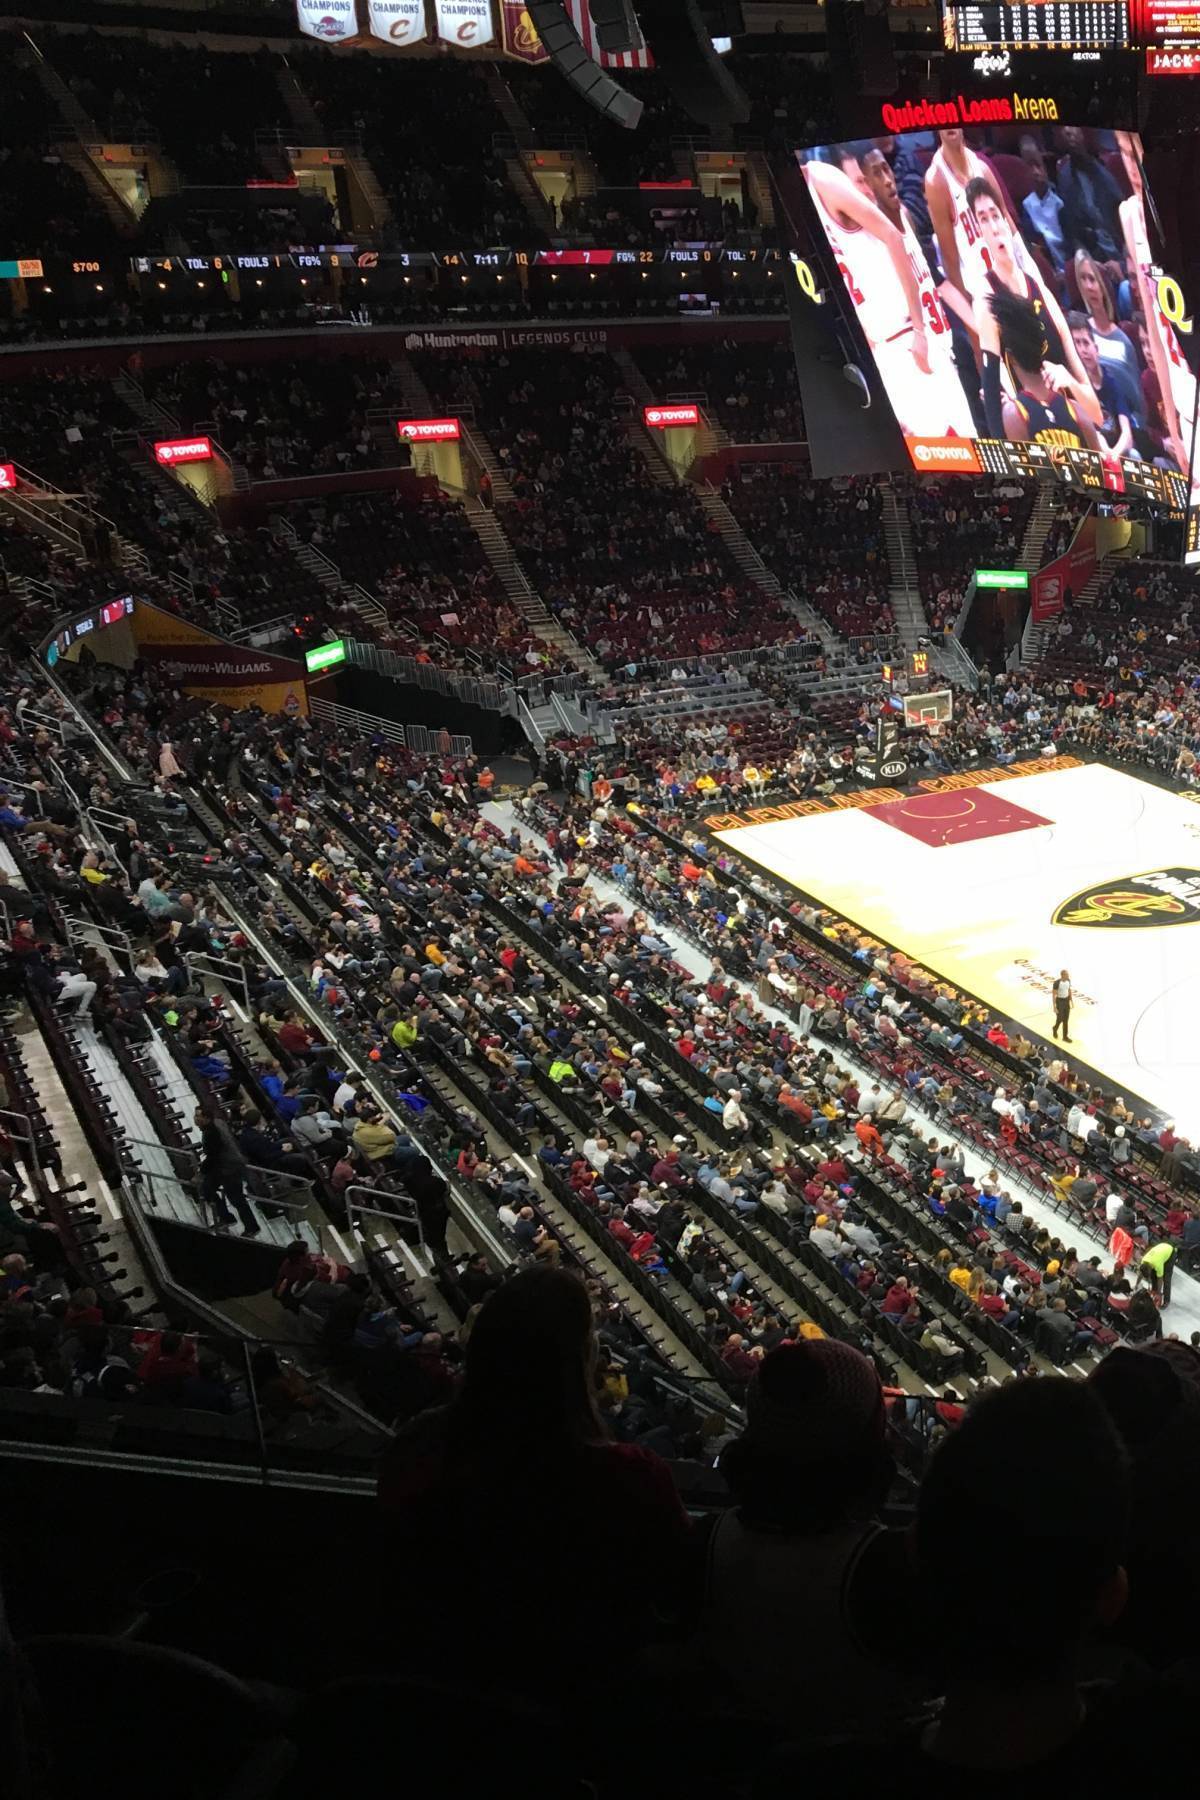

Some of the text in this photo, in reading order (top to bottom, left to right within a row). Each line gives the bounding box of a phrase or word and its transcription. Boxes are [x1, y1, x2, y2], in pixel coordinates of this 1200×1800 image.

[302, 2, 350, 11] CHAMPIONS
[373, 5, 419, 13] CHAMPIONS
[441, 6, 487, 16] CHAMPIONS
[882, 92, 1059, 133] Quicken Loans Arena
[214, 257, 222, 269] 6
[238, 256, 269, 268] FOULS
[299, 256, 321, 267] FG%
[443, 254, 459, 265] 14
[474, 254, 499, 264] 7:11
[583, 252, 590, 263] 7
[616, 252, 636, 263] FG%
[639, 251, 654, 263] 22
[670, 251, 699, 262] FOULS
[73, 261, 100, 272] $700
[796, 259, 826, 305] Q
[1157, 277, 1193, 334] Q
[424, 332, 498, 348] Huntington
[511, 331, 571, 346] LEGENDS
[661, 410, 695, 421] TOYOTA
[417, 424, 456, 435] TOYOTA
[173, 443, 209, 457] TOYOTA
[929, 446, 972, 460] TOYOTA
[885, 765, 902, 774] KIA
[704, 755, 1085, 830] CLEVELAND CAVALIERS
